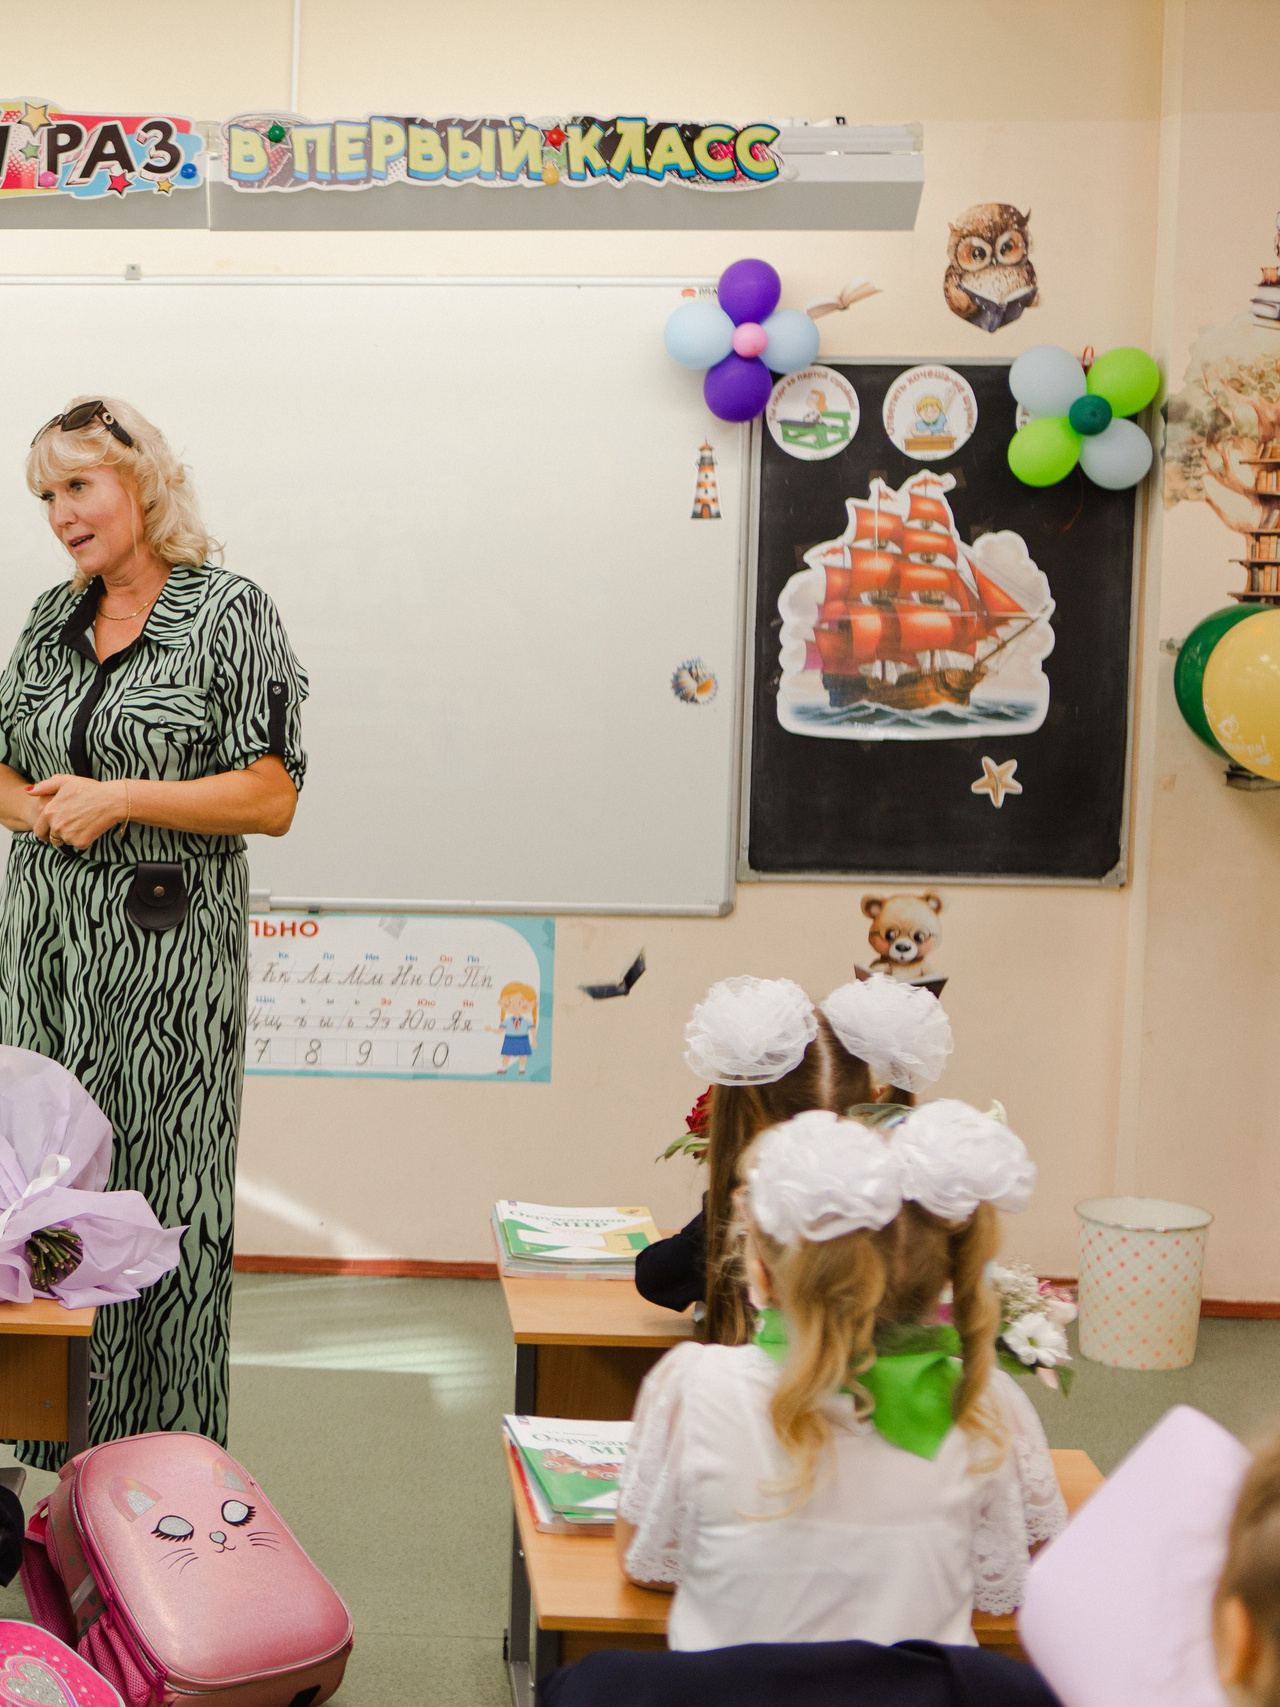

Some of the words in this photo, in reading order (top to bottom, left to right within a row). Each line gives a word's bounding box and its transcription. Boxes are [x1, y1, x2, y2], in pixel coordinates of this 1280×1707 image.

[40, 118, 181, 187] РАЗ
[229, 124, 271, 182] В
[290, 115, 544, 182] ПЕРВЫЙ
[566, 116, 781, 182] КЛАСС
[698, 287, 719, 297] BRA
[248, 920, 319, 938] ЛЬНО
[255, 1038, 271, 1064] 7
[305, 1039, 322, 1065] 8
[355, 1040, 373, 1066] 9
[411, 1041, 449, 1068] 10
